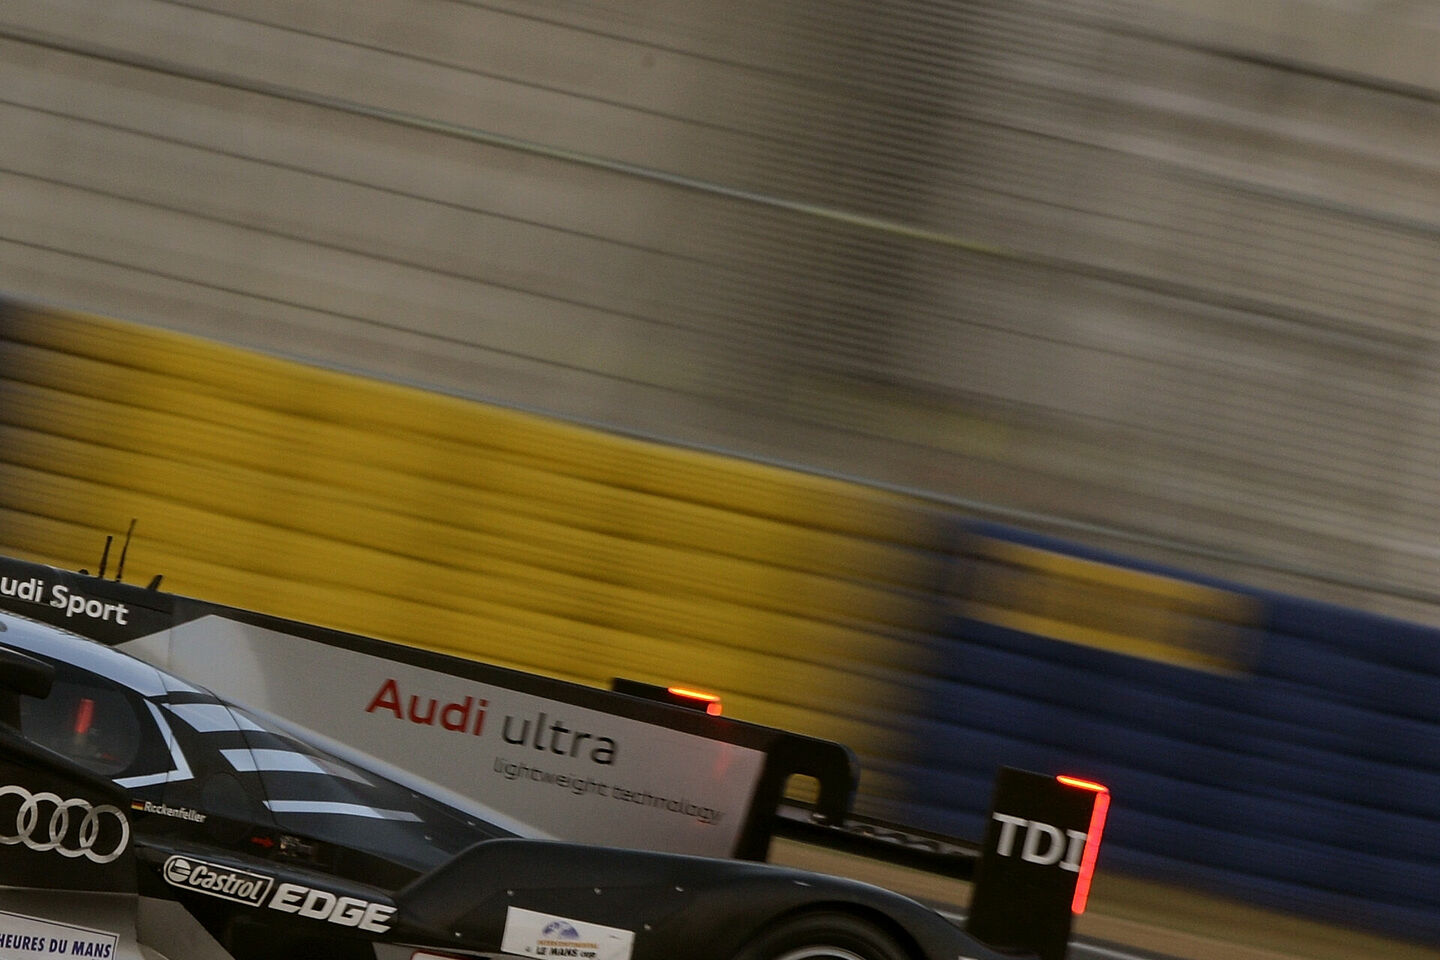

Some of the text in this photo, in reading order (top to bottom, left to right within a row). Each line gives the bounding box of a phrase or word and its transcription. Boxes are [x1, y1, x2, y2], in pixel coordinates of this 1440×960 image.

[49, 584, 129, 625] Sport
[366, 678, 619, 767] Audi ultra
[144, 801, 206, 823] Rockenfeller
[493, 756, 727, 826] lightweight technology
[992, 811, 1088, 873] TDI
[188, 864, 398, 933] Castrol EDGE
[48, 938, 68, 954] DU
[71, 941, 111, 958] MANS
